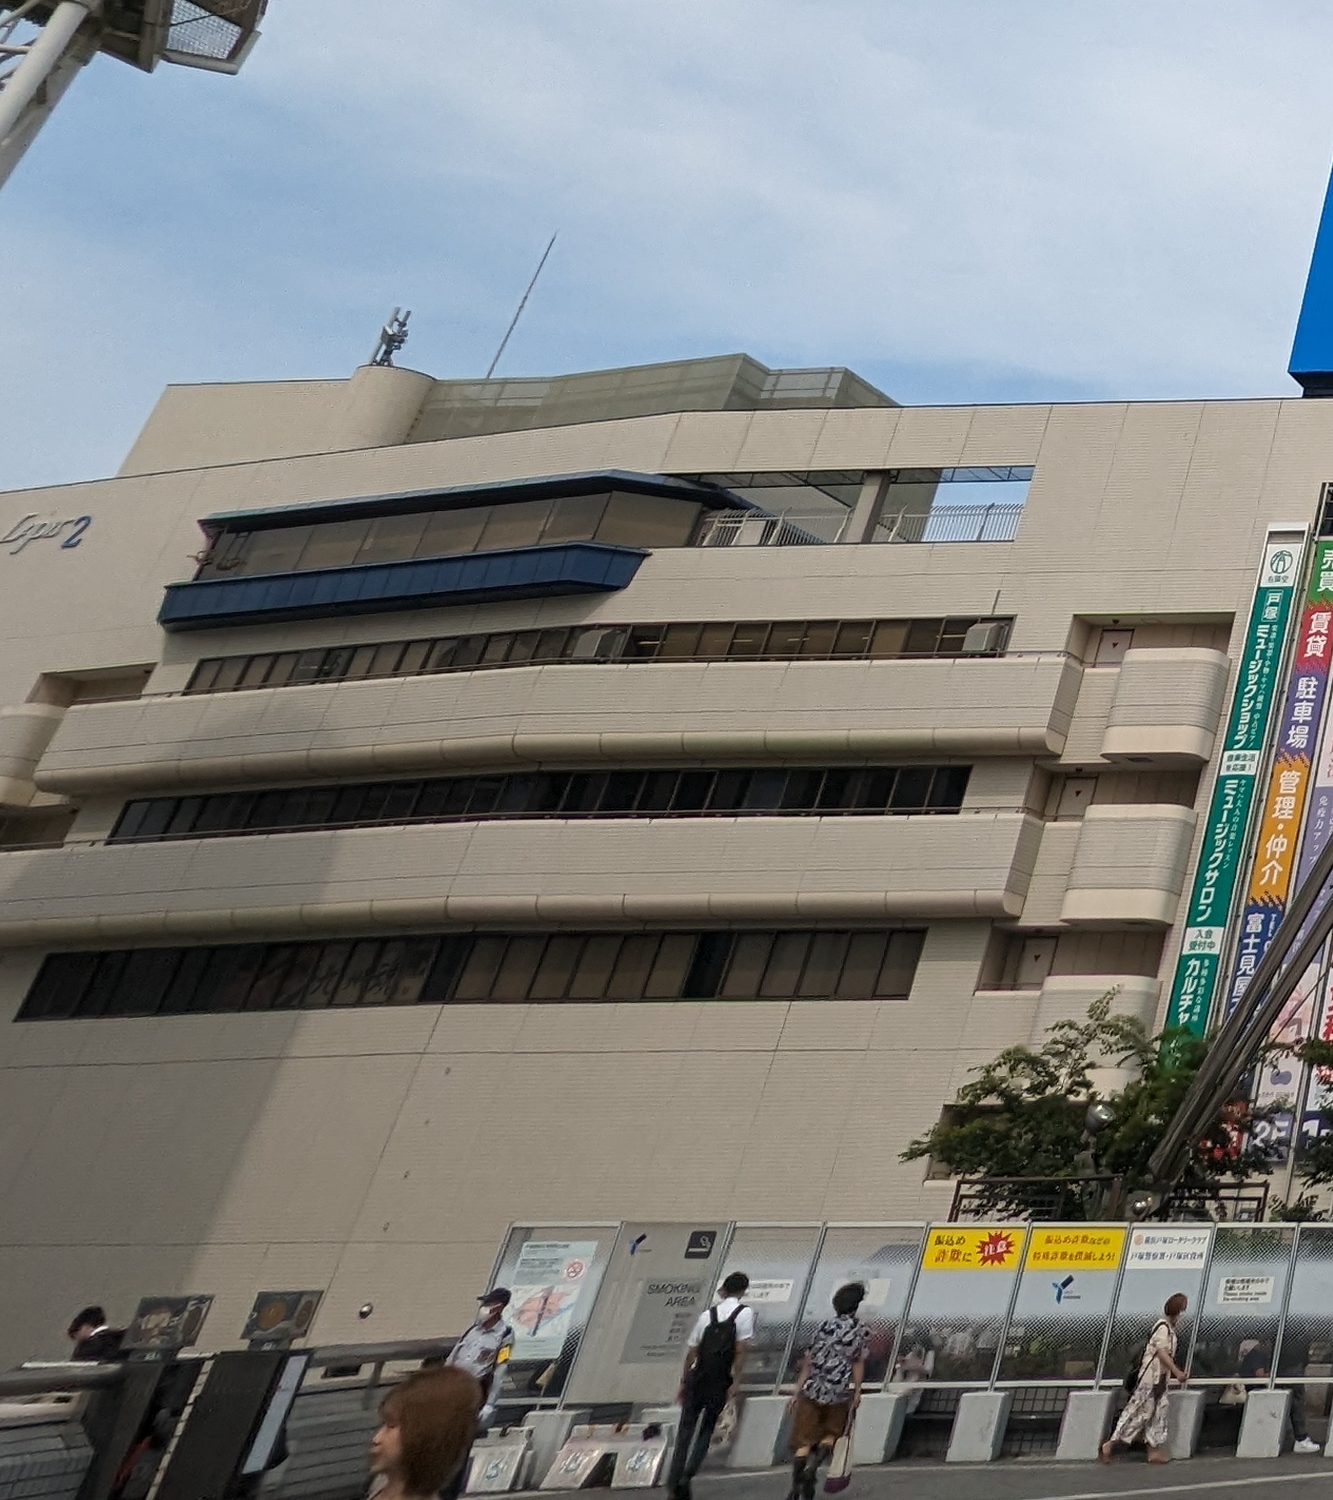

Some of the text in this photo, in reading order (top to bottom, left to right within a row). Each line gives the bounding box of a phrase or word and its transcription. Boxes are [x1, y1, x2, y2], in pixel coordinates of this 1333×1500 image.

[61, 516, 92, 549] 2
[1264, 592, 1283, 619] 戸塚
[1304, 612, 1331, 658] 賃貸
[1233, 625, 1270, 749] ミュージックショップ
[1287, 677, 1318, 748] 駐車場
[1259, 770, 1301, 886] 管理・仲介
[1196, 779, 1238, 922] ミュージックサロン
[1195, 929, 1213, 938] 入会
[1188, 940, 1216, 951] 受付中
[934, 1235, 966, 1246] 振込め
[1045, 1234, 1110, 1245] 振込め詐欺などの
[1144, 1236, 1207, 1245] 横浜戸塚ロータリークラブ
[934, 1249, 972, 1263] 詐欺に
[984, 1240, 1008, 1257] 注意
[664, 1296, 696, 1308] AREA
